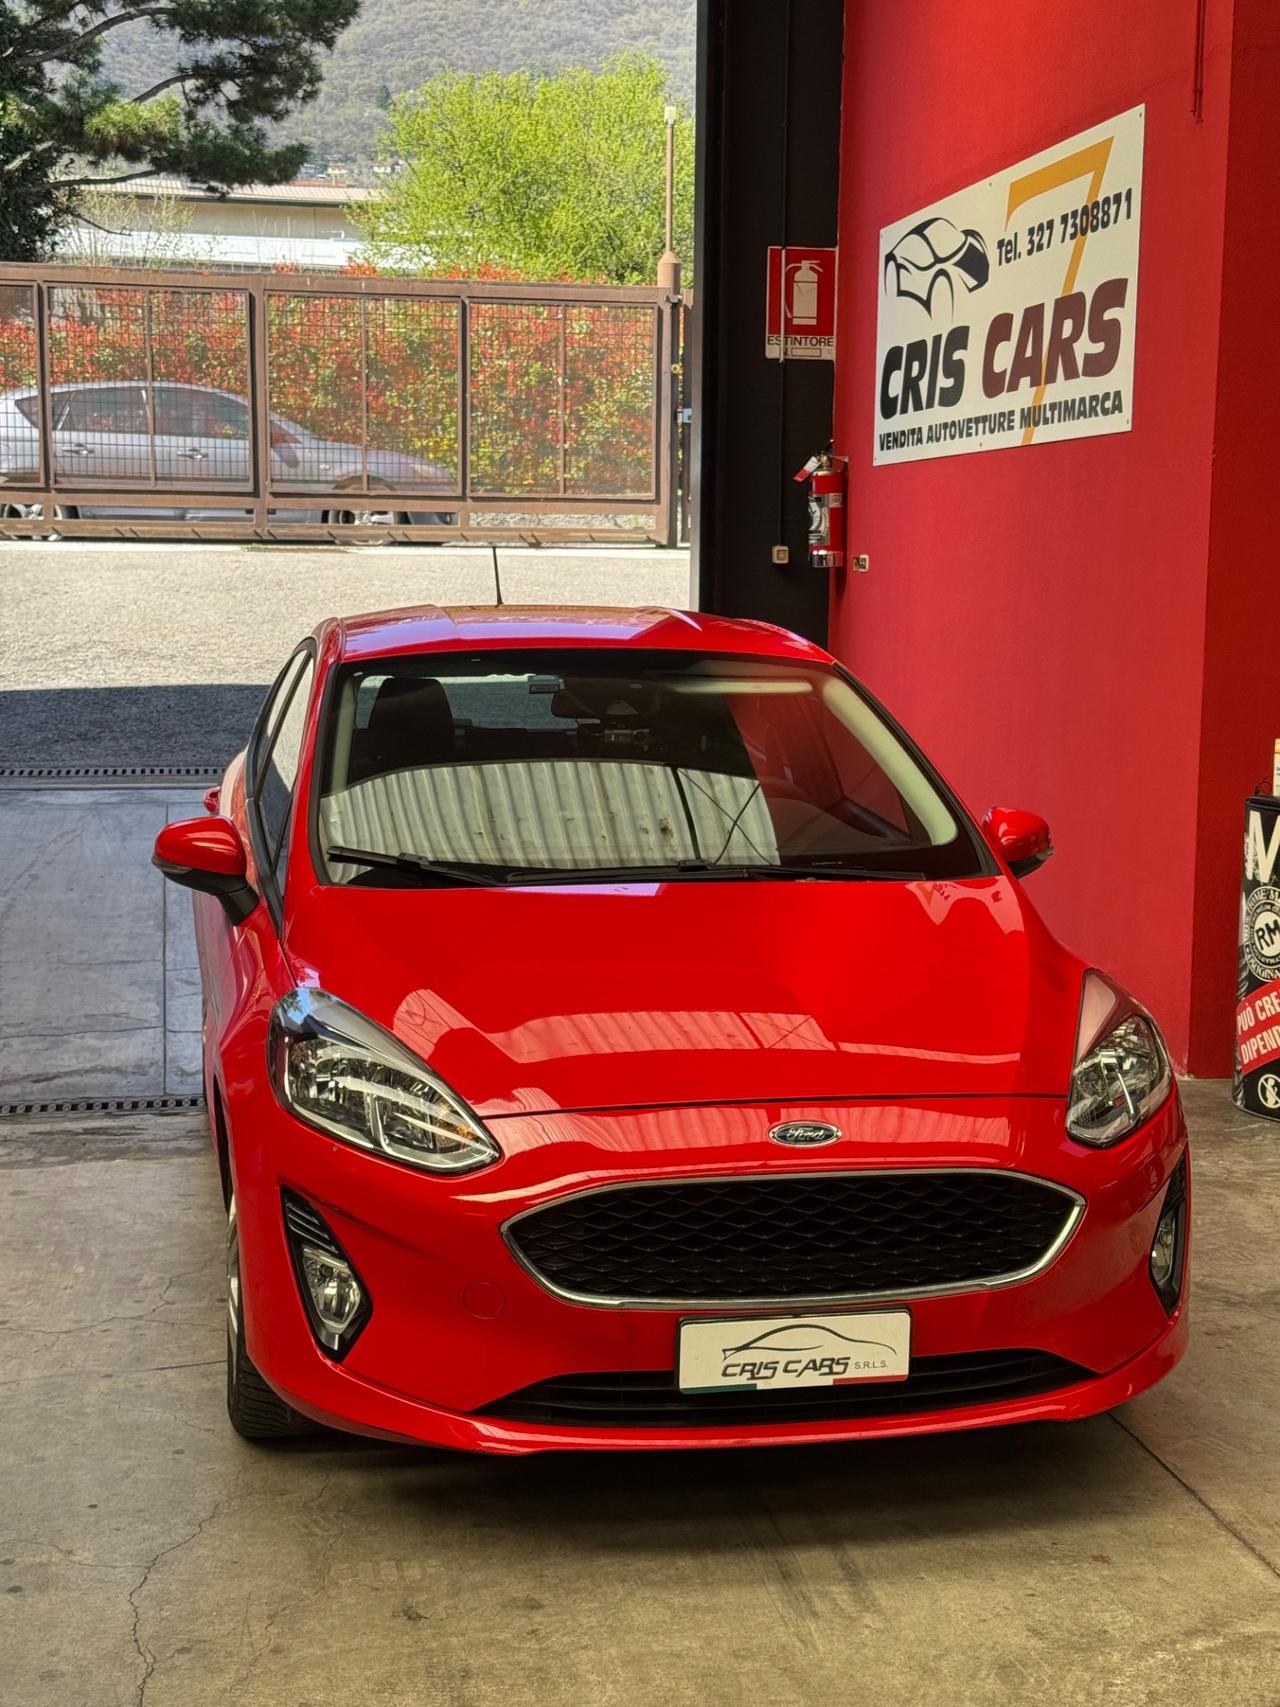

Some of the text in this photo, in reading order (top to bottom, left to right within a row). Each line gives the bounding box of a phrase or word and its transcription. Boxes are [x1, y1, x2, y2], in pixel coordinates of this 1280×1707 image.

[997, 188, 1132, 266] Tel. 327 7308871
[767, 335, 834, 347] ESTINTORE
[880, 278, 1129, 420] CRIS CARS
[879, 390, 1123, 451] VENDITA AUTOVETTURE MULTIMARCA
[786, 1127, 825, 1140] Ford
[721, 1356, 889, 1381] CRIS CARS S.R.L.S.
